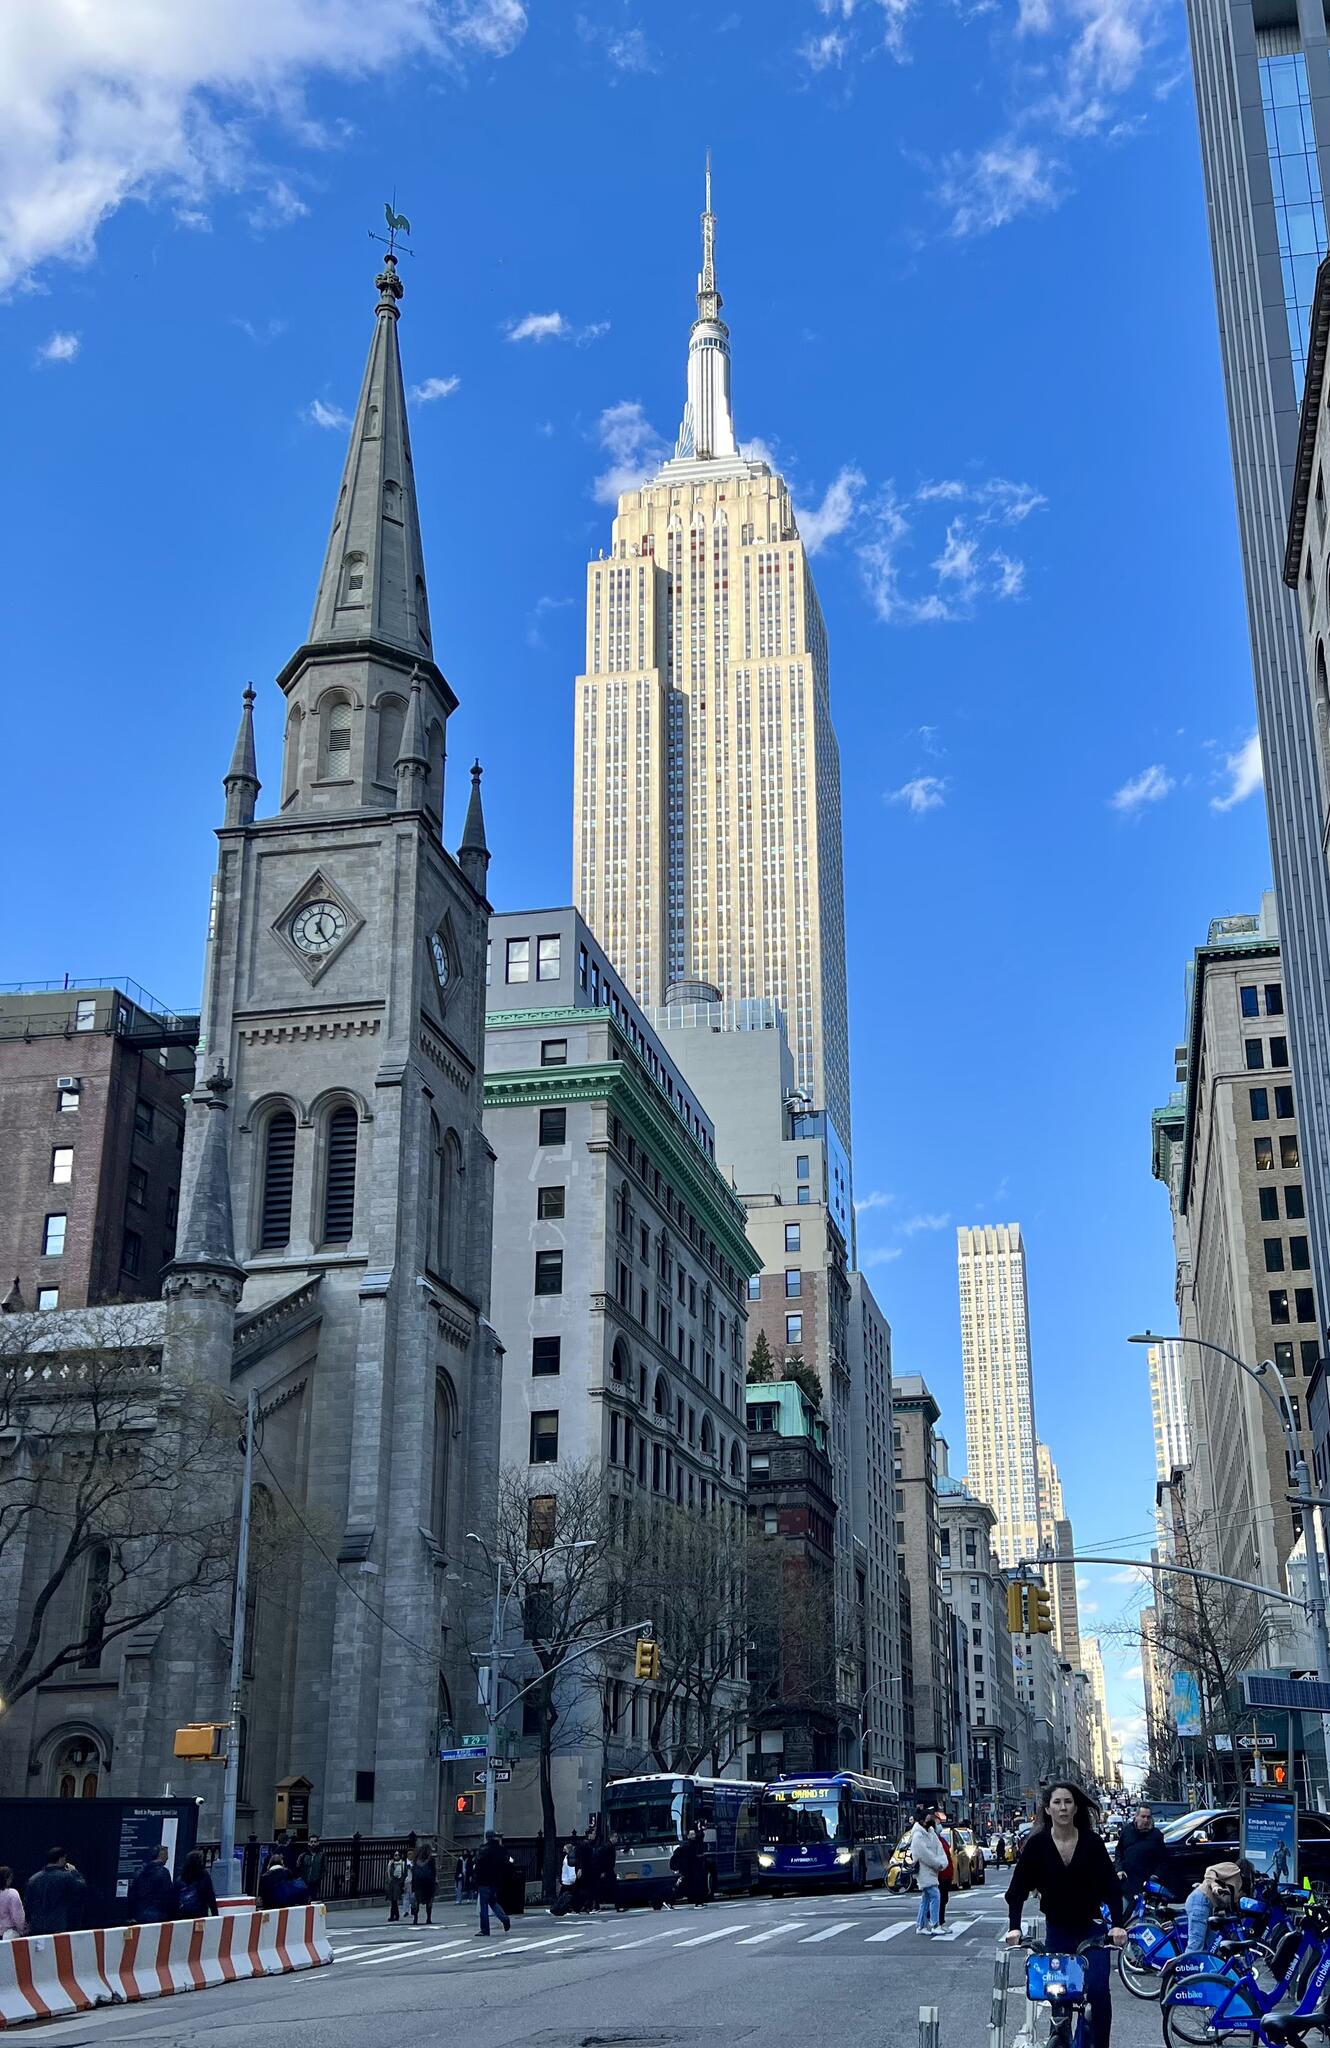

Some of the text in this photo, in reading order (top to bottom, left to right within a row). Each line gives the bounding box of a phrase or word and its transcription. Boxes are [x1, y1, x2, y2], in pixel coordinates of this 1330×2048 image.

[471, 1736, 480, 1745] 29
[818, 1789, 829, 1798] ST
[1248, 1818, 1268, 1826] Embark
[1175, 1963, 1199, 1972] citi bike
[1175, 1990, 1203, 2000] citi bike
